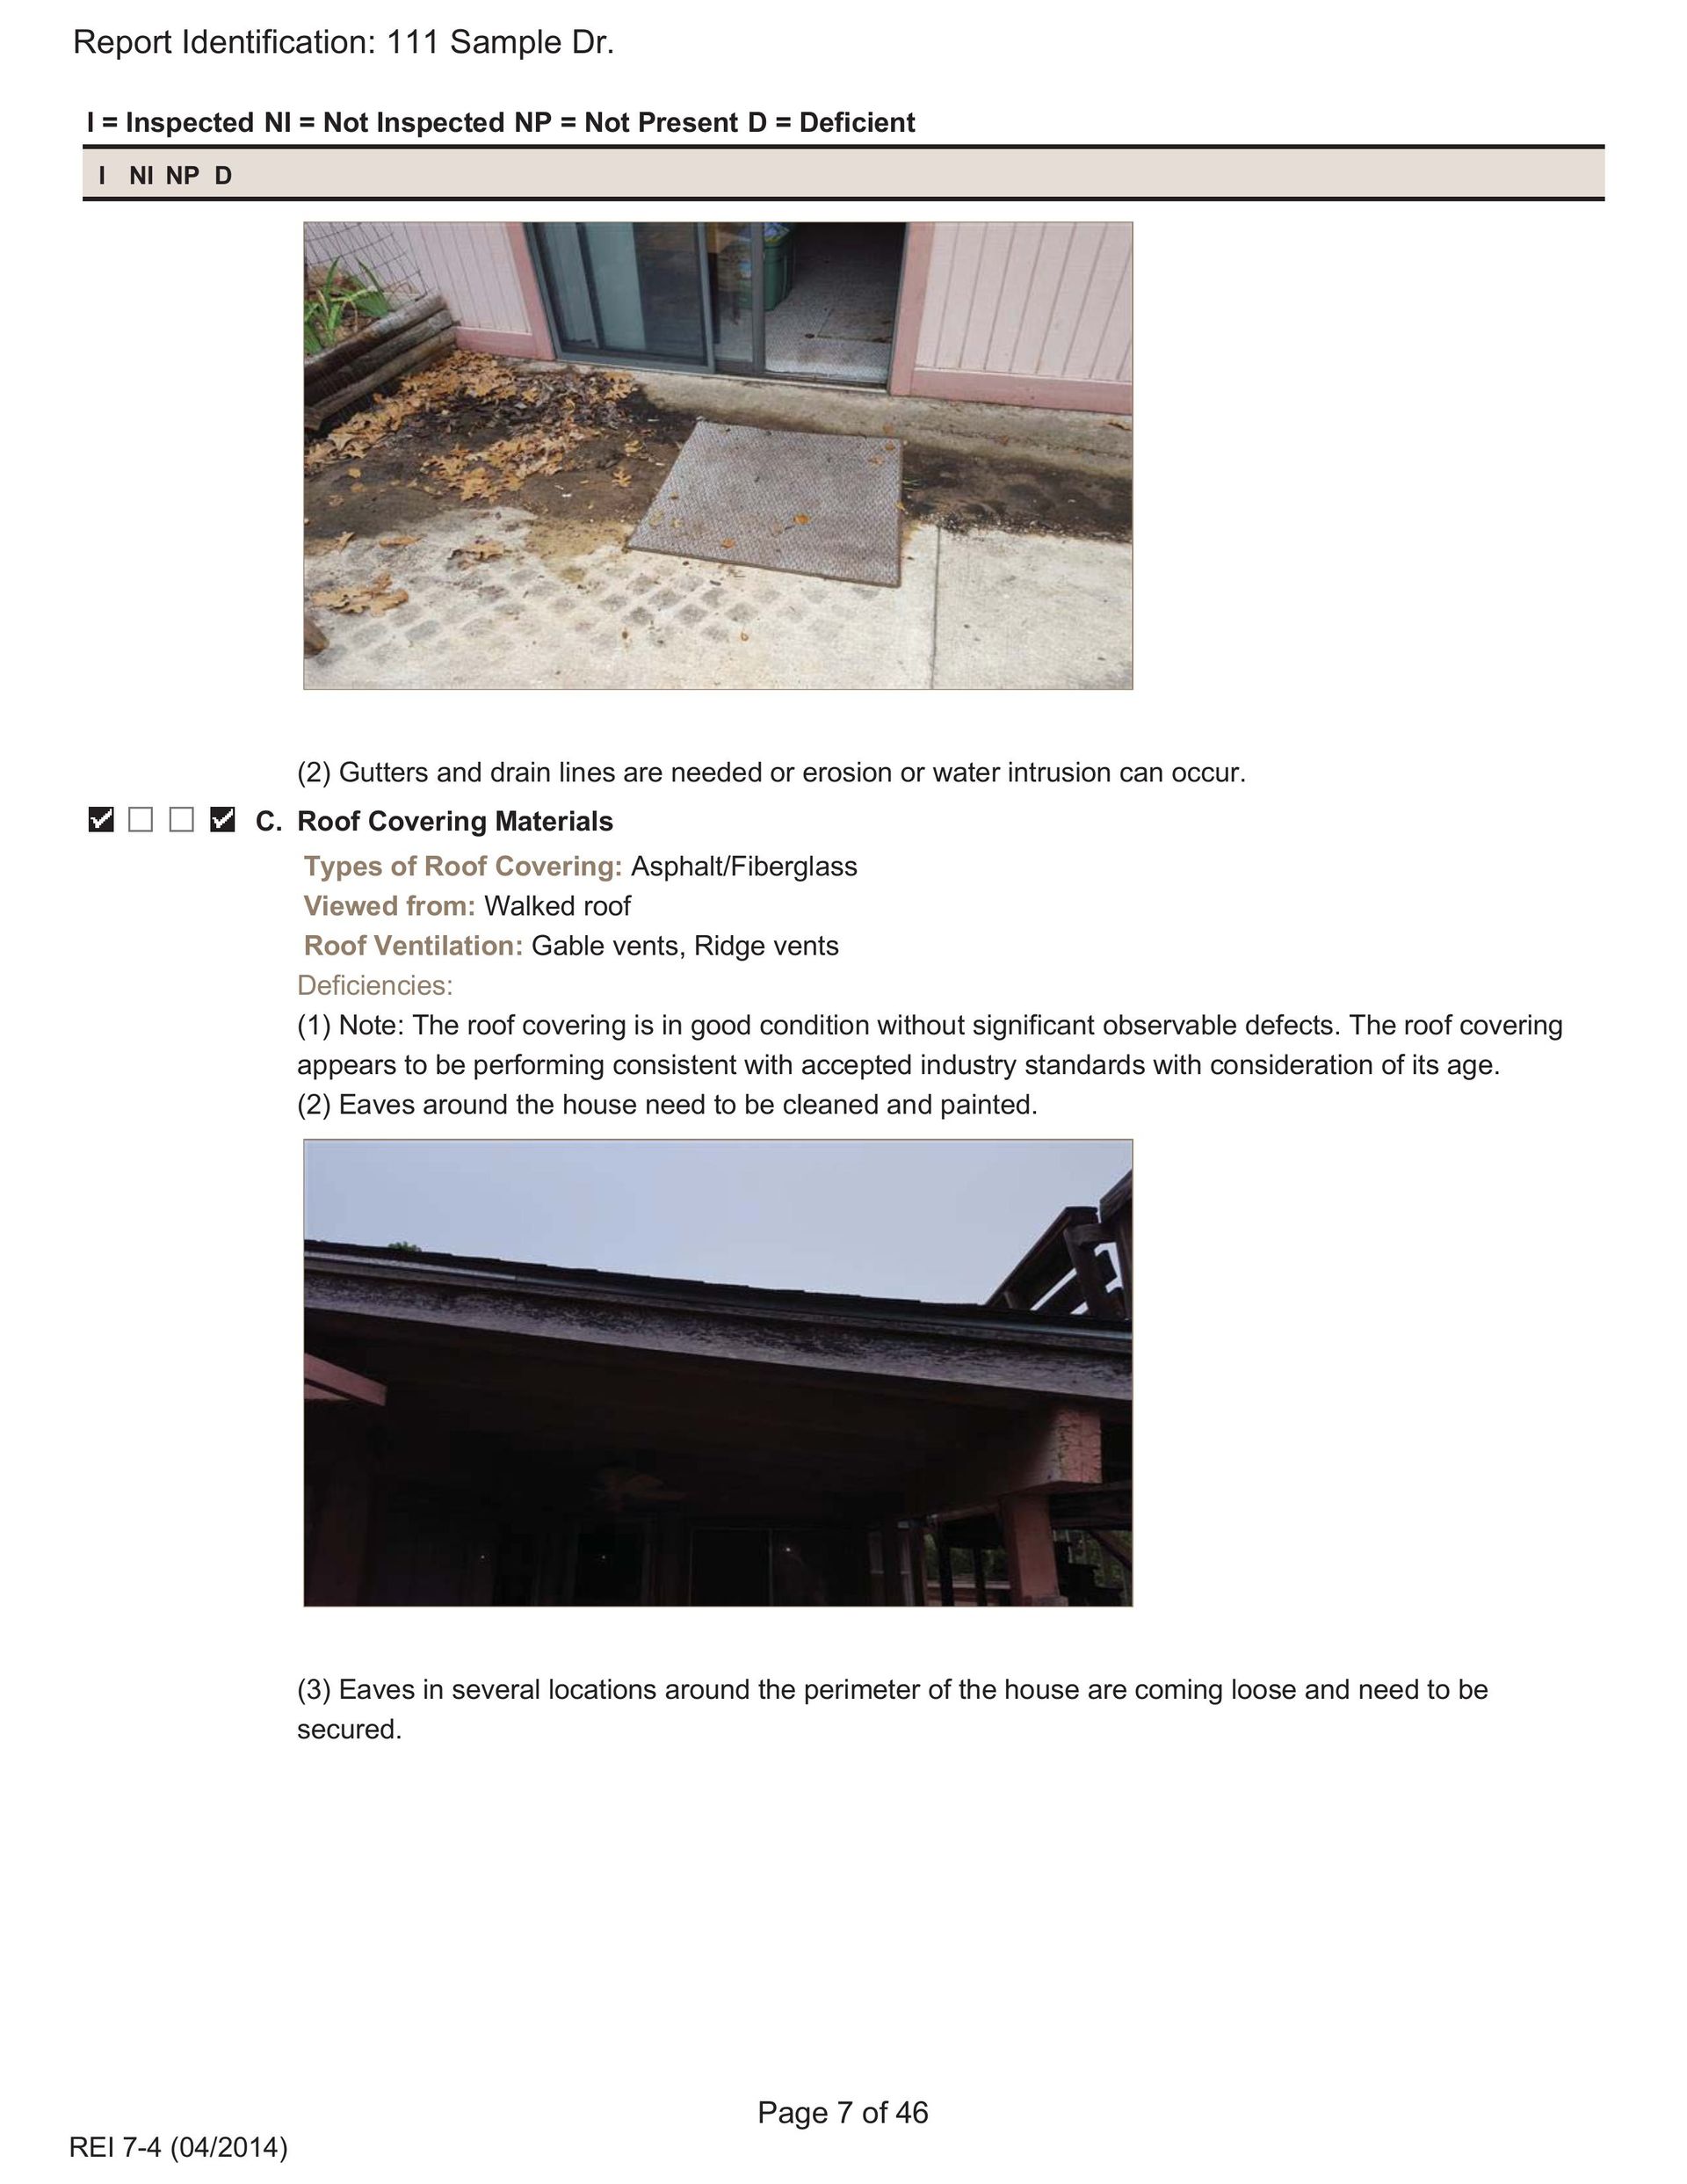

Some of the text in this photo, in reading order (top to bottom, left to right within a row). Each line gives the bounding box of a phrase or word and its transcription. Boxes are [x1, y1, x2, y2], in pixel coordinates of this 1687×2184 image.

[75, 29, 612, 60] Report Identification: 111 Sample Dr.
[88, 112, 916, 138] I = Inspected NI = Not Inspected NP = Not Present D = Deficient
[100, 166, 231, 185] I NI NP D
[299, 761, 1245, 787] (2) Gutters and drain lines are needed or erosion or water intrusion can occur.
[257, 810, 613, 837] C. Roof Covering Materials
[304, 855, 858, 882] Types of Roof Covering: Asphalt/Fiberglass
[304, 895, 632, 916] Viewed from: Walked roof
[306, 934, 839, 961] Roof Ventilation: Gable vents, Ridge vents
[299, 975, 452, 995] Deficiencies:
[299, 1014, 1562, 1041] (1) Note: The roof covering is in good condition without significant observable defects. The roof covering
[298, 1054, 1499, 1080] appears to be performing consistent with accepted industry standards with consideration of its age.
[299, 1093, 1036, 1120] (2) Eaves around the house need to be cleaned and painted.
[299, 1678, 1488, 1705] (3) Eaves in several locations around the perimeter of the house are coming loose and need to be
[298, 1718, 401, 1739] secured.
[759, 2101, 928, 2130] Page 7 of 46
[70, 2137, 287, 2163] REI 7-4 (04/2014)
